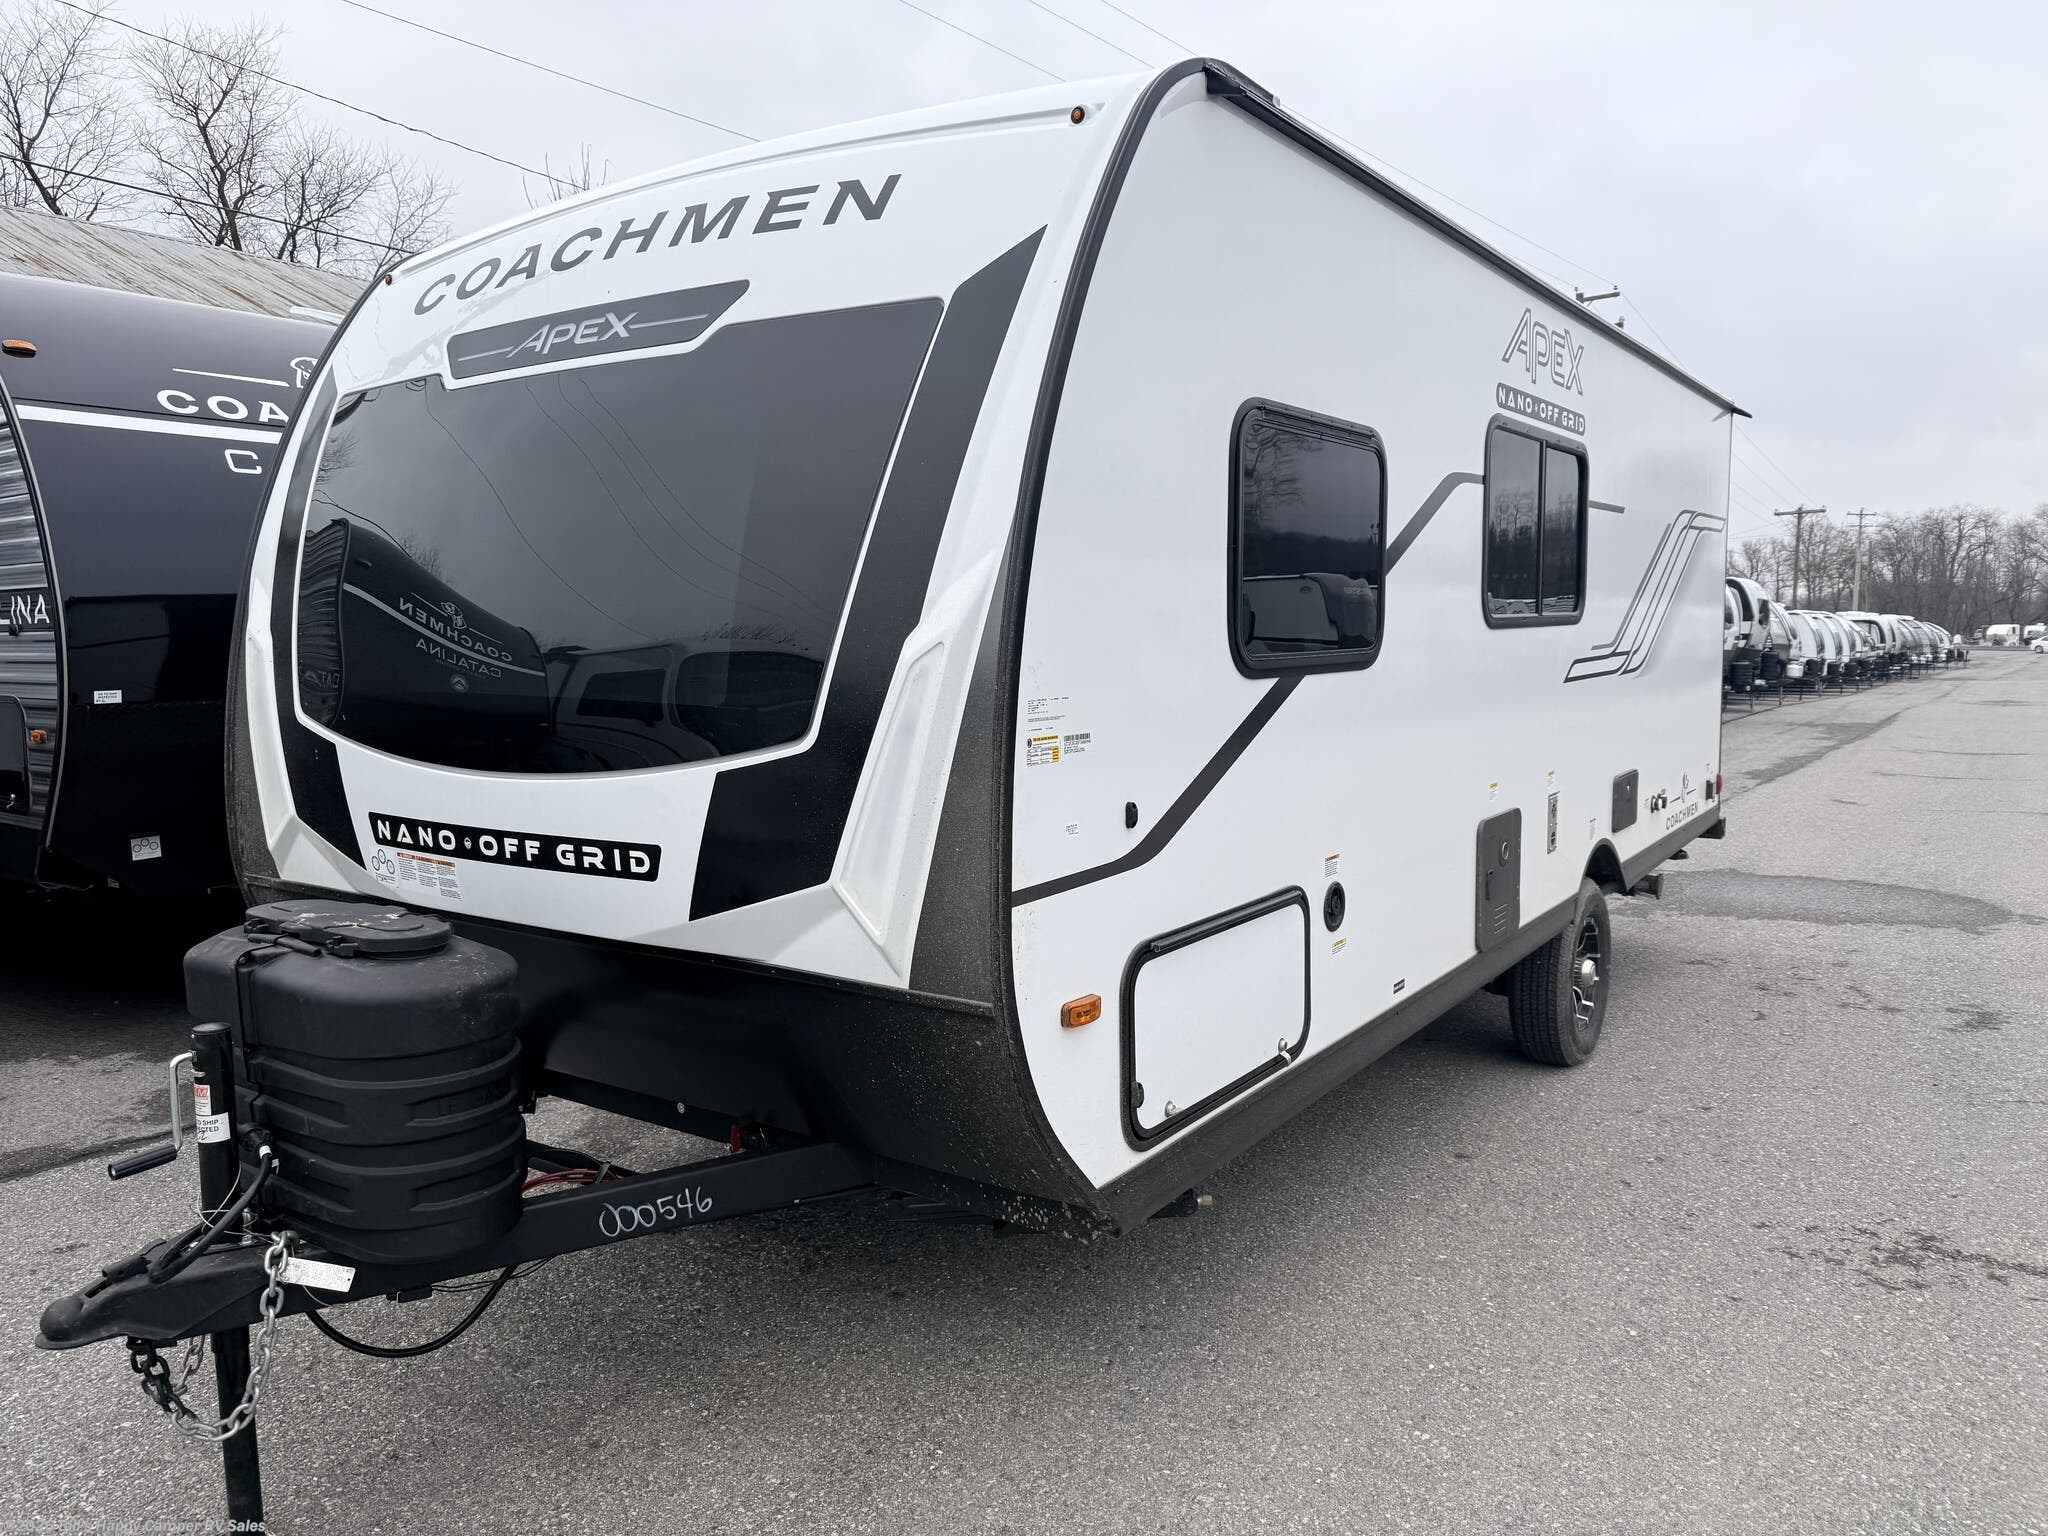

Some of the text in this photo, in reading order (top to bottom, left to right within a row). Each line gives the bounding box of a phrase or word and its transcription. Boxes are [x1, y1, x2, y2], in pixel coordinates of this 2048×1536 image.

[414, 173, 902, 316] COACHMEN
[505, 311, 639, 359] APEX
[1502, 307, 1584, 396] APEX
[1498, 386, 1585, 433] NANO OFF GRID
[1665, 801, 1698, 831] COACHMEN
[377, 819, 651, 875] NANO OFF GRID
[598, 1185, 713, 1237] 000546
